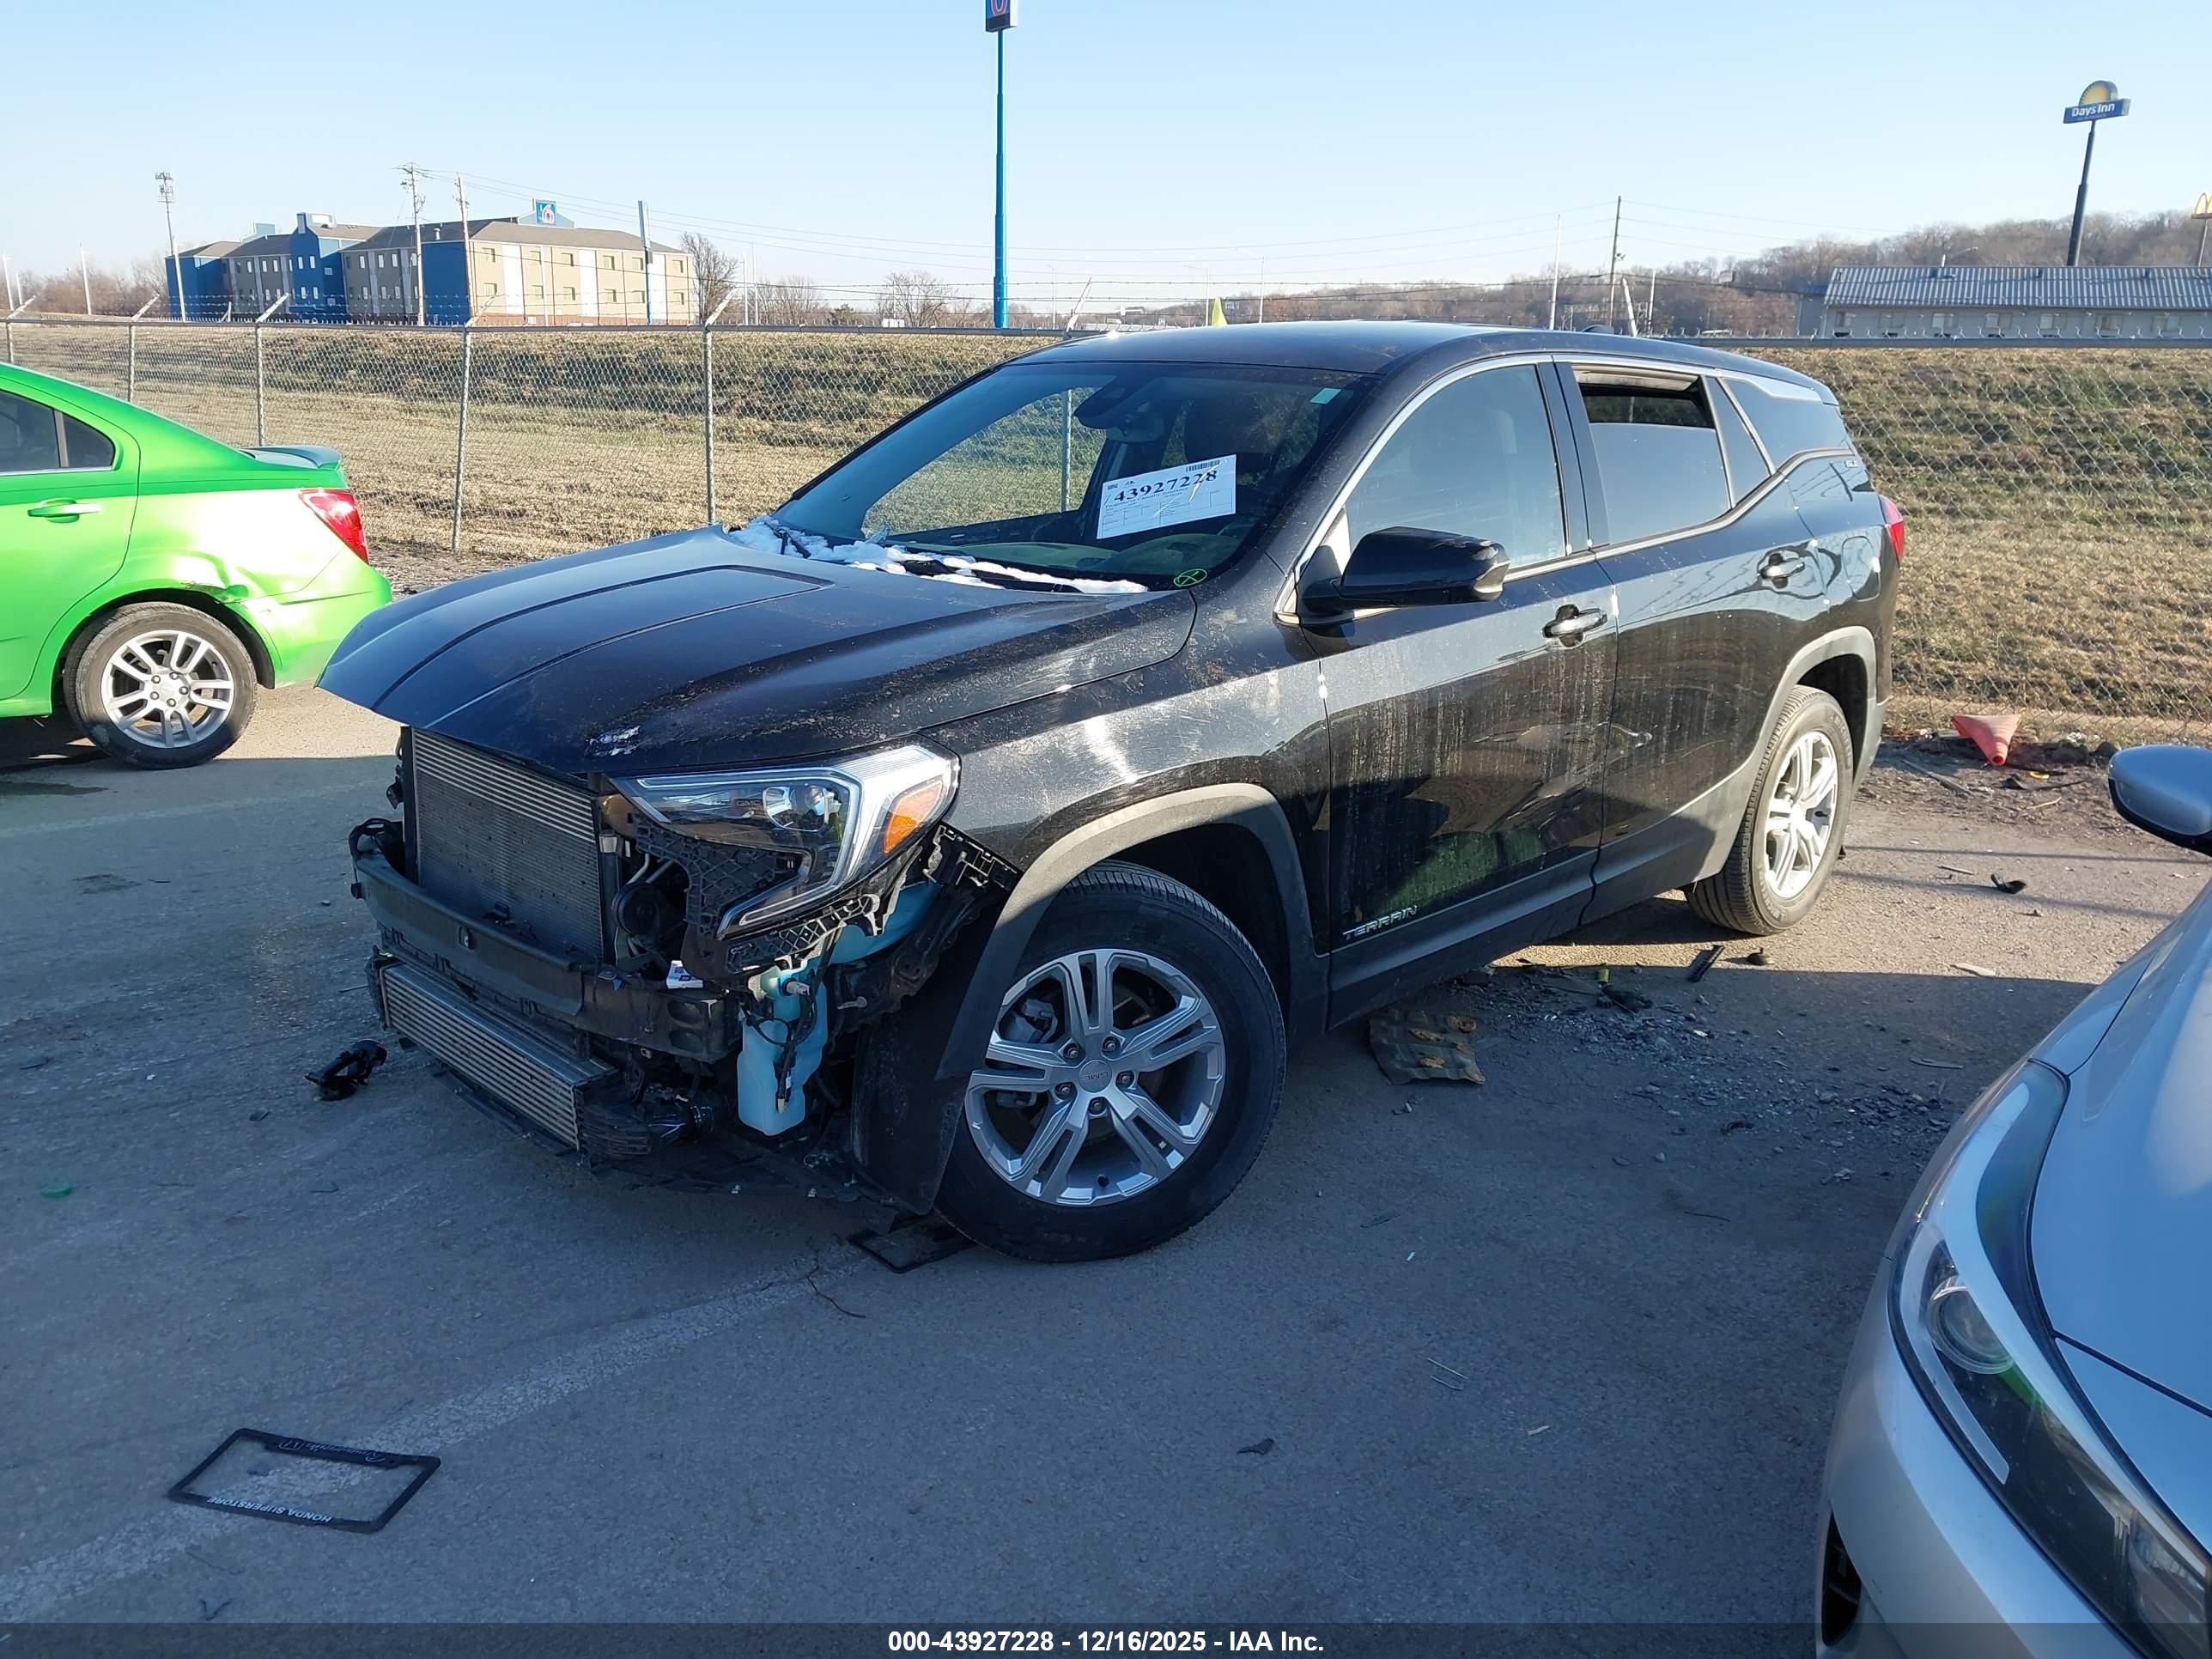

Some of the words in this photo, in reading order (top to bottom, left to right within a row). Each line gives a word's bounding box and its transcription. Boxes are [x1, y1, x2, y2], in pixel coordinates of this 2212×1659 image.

[2071, 106, 2097, 118] Days
[2097, 103, 2115, 113] Inn
[542, 204, 555, 224] 6
[1114, 470, 1218, 502] 43927228
[1342, 904, 1419, 941] TERRAIN
[206, 1496, 286, 1515] SUPERSTORE
[288, 1508, 333, 1523] HONDA
